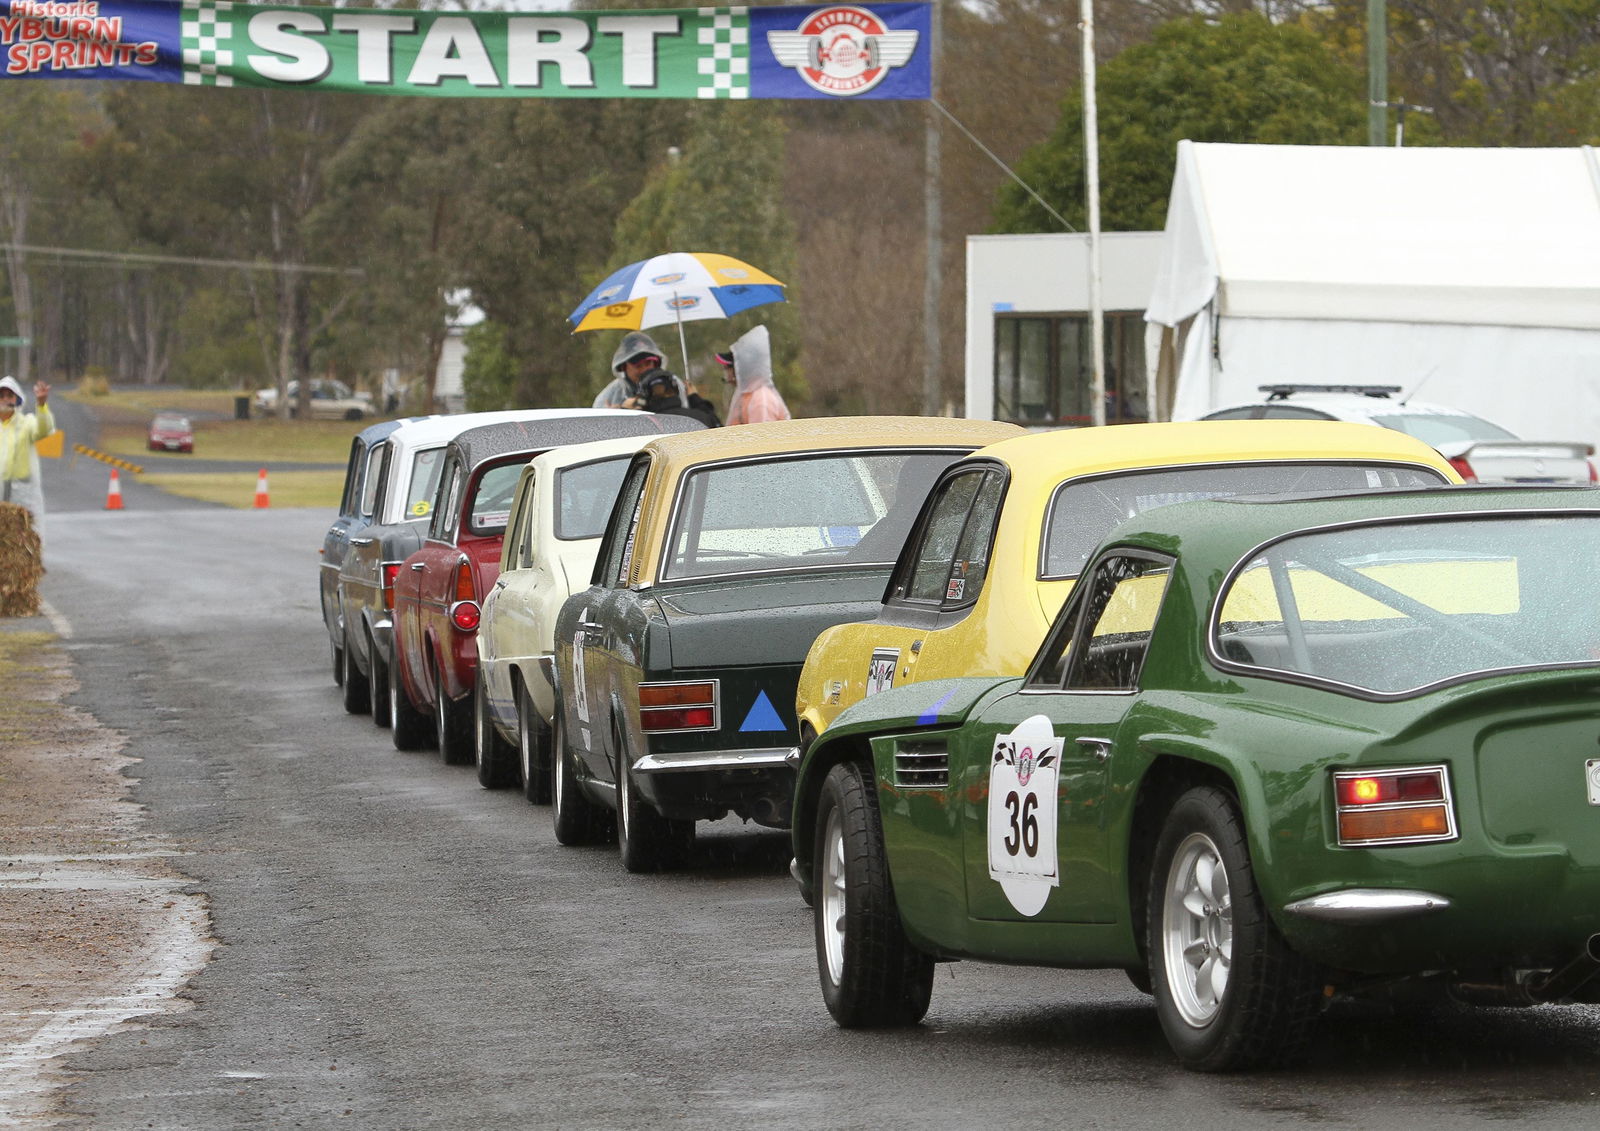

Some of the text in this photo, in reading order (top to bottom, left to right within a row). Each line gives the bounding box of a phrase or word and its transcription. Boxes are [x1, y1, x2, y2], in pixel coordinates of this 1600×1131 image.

[10, 0, 98, 17] Historic
[8, 41, 157, 74] SPRINTS
[247, 10, 681, 88] START
[1004, 791, 1039, 858] 36
